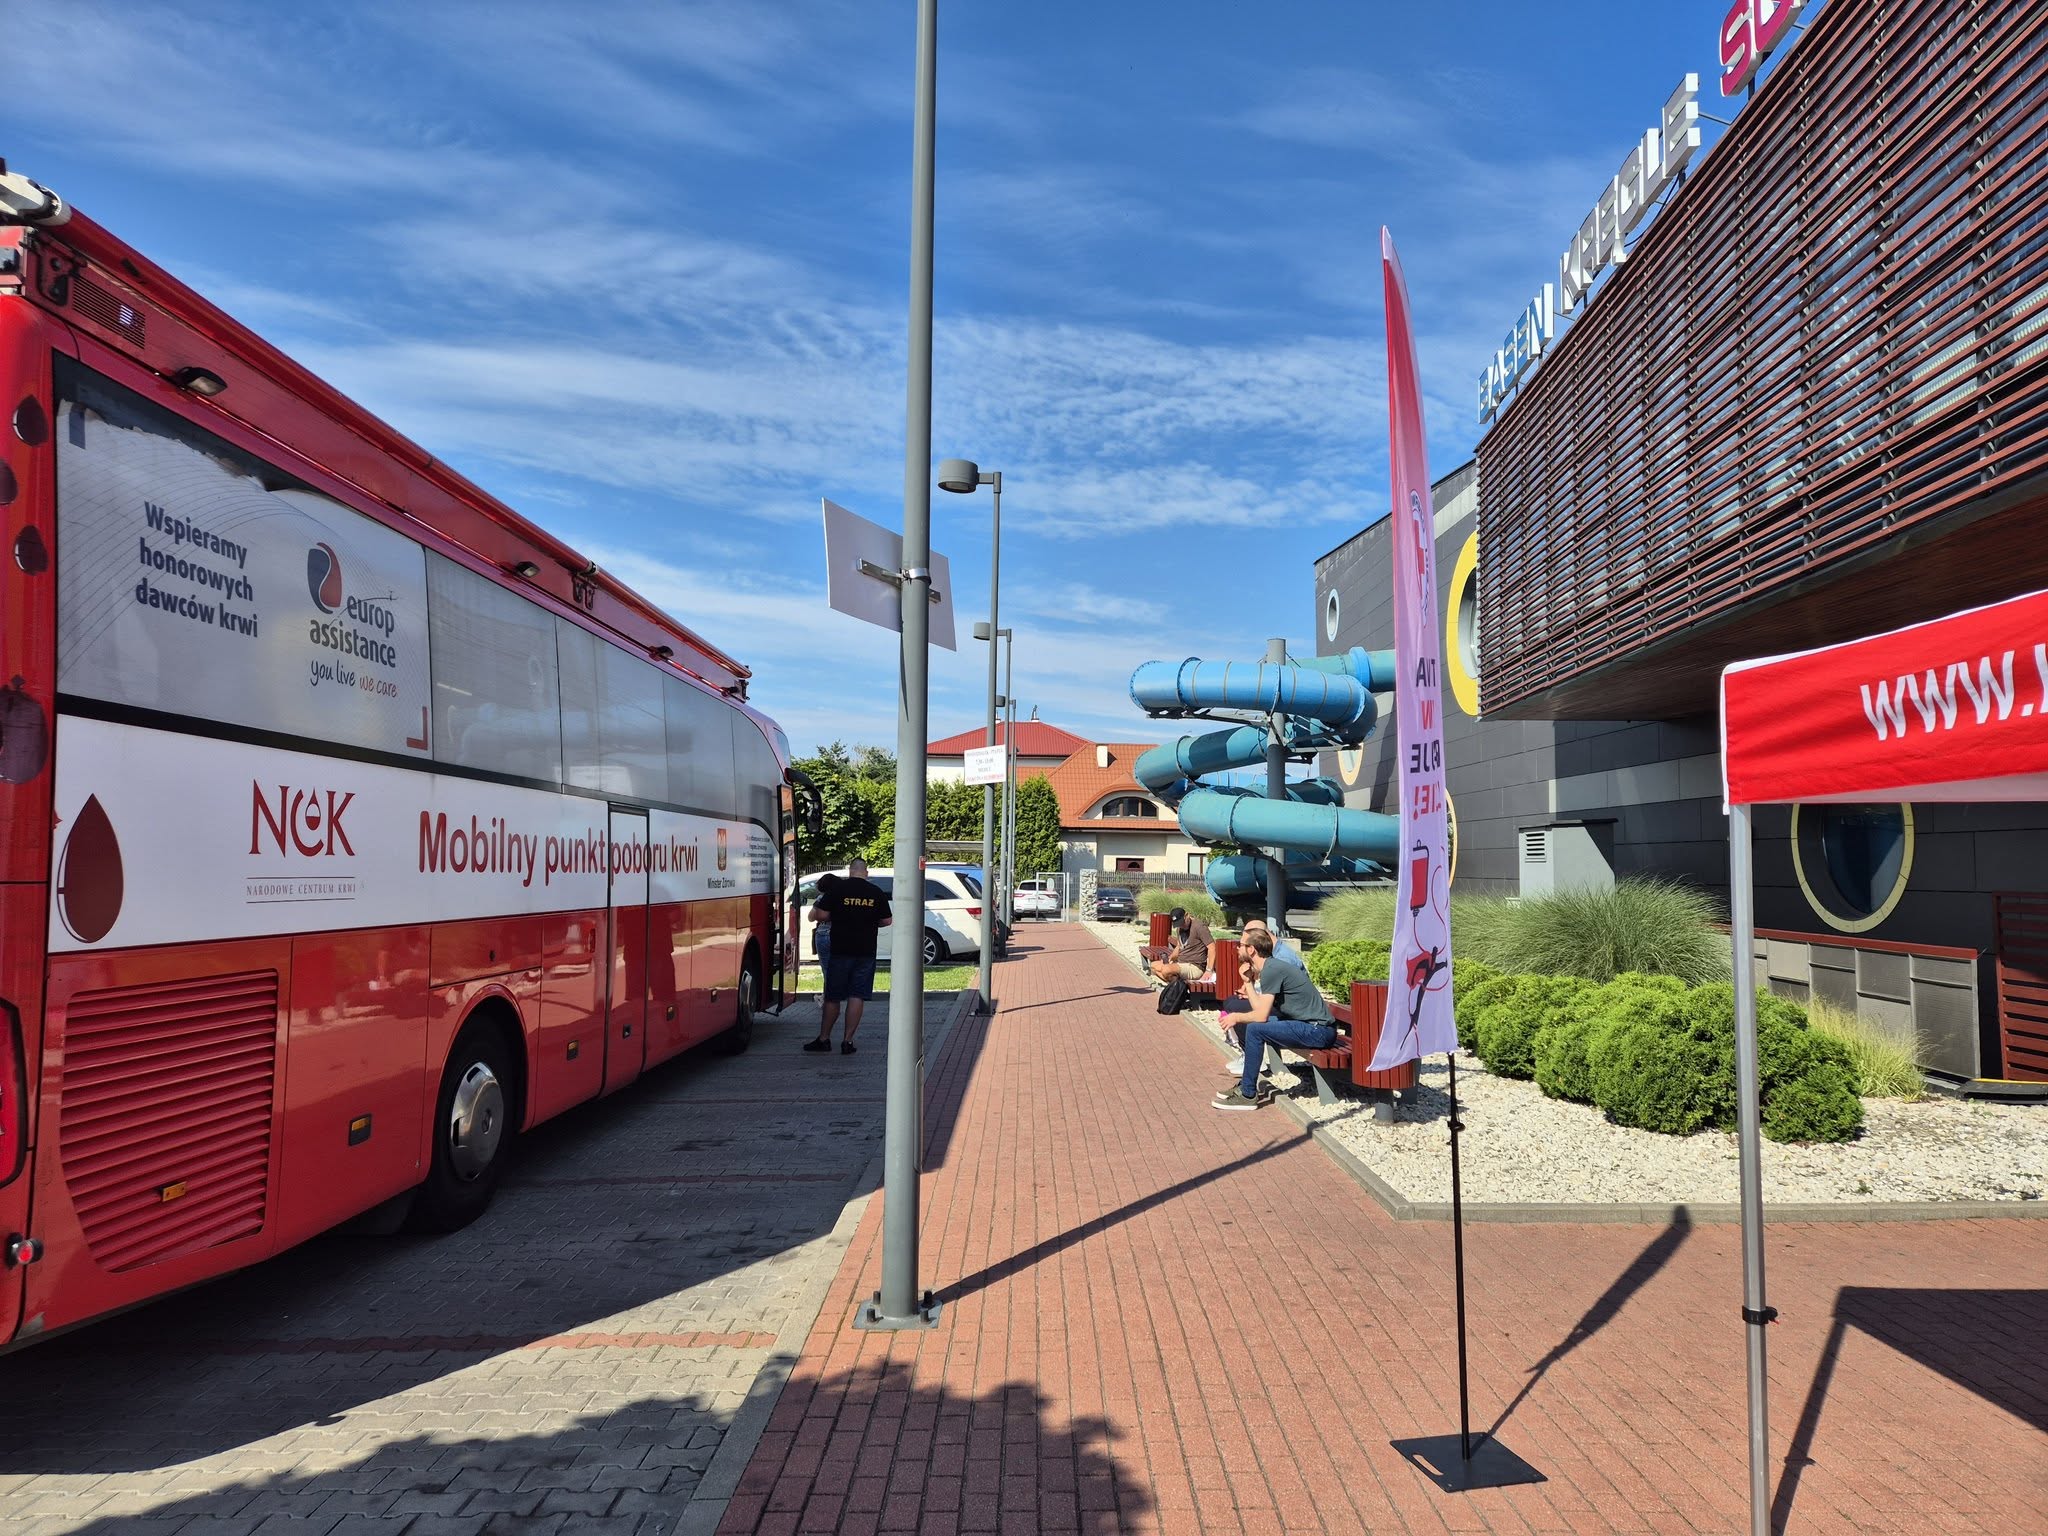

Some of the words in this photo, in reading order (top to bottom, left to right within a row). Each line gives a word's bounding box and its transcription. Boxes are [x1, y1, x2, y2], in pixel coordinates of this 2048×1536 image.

[144, 500, 247, 569] Wspieramy
[140, 536, 253, 602] honorowych
[136, 577, 215, 624] dawców
[219, 603, 258, 638] krwi
[347, 595, 394, 637] europ
[309, 619, 396, 668] assistance
[310, 660, 334, 687] you
[336, 659, 355, 687] live
[359, 676, 374, 692] we
[376, 681, 398, 698] care
[248, 778, 356, 858] NCK
[419, 810, 537, 888] Mobilny
[545, 827, 606, 887] punkt
[611, 831, 667, 887] poboru
[671, 834, 698, 873] krwi
[246, 884, 293, 896] NARODOWE
[298, 883, 334, 894] CENTRUM
[338, 883, 356, 893] KRWI
